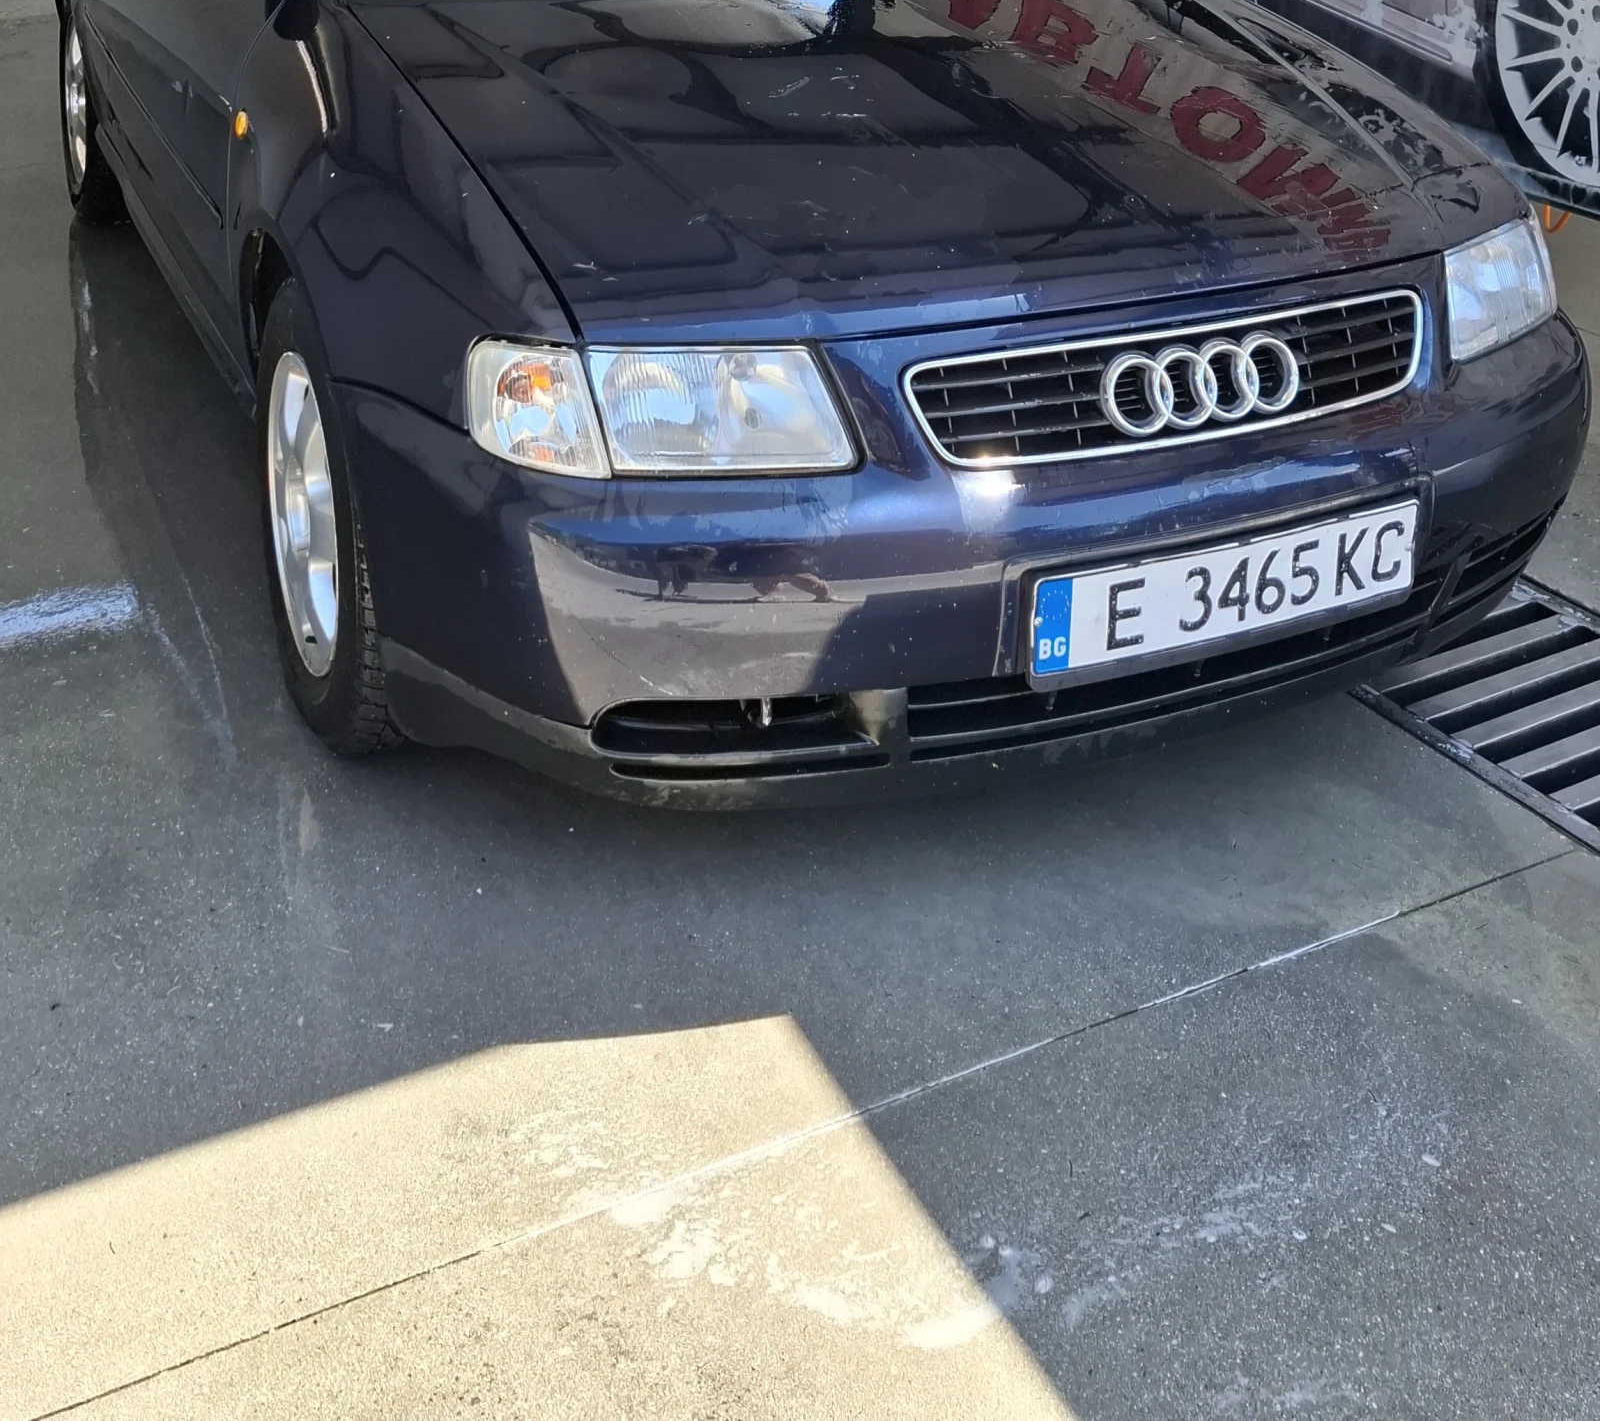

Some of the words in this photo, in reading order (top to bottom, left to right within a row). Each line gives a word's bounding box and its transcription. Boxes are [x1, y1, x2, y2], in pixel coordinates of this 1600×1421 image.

[1106, 577, 1145, 651] E
[1178, 538, 1320, 632] 3465
[1038, 636, 1067, 662] BG
